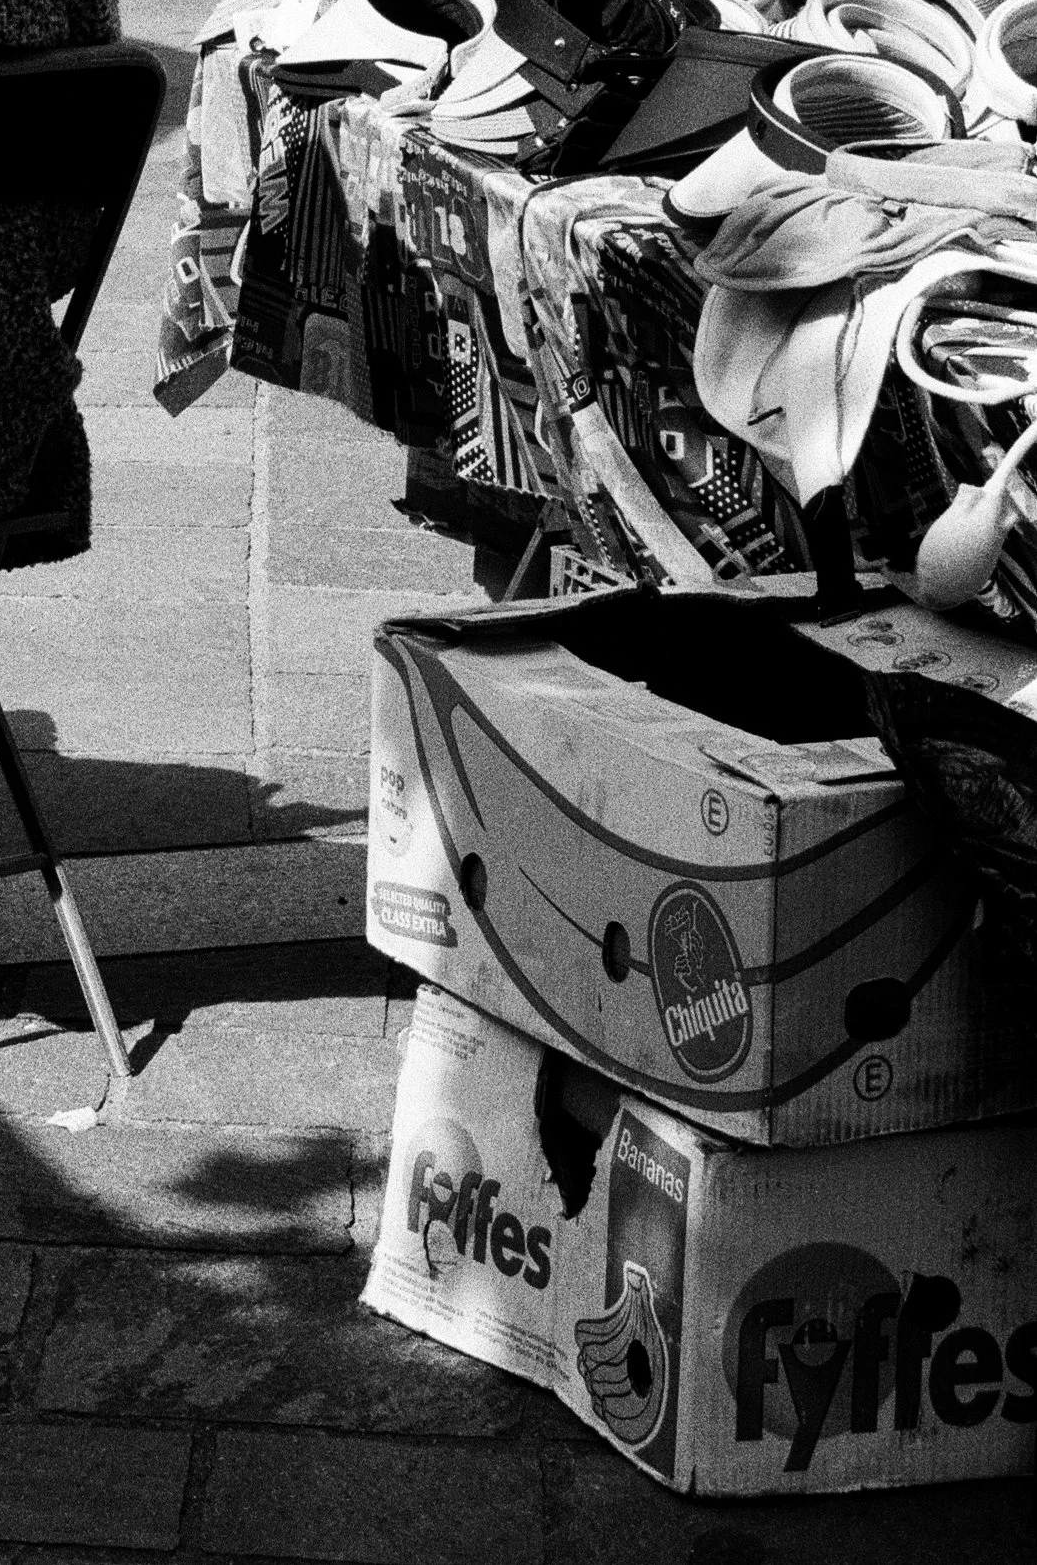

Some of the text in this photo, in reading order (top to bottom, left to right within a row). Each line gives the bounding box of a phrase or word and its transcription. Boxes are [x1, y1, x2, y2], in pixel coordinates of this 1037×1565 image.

[381, 906, 448, 938] CLASS EXTRA
[664, 978, 750, 1048] Chiquita
[617, 1127, 685, 1204] Bananas
